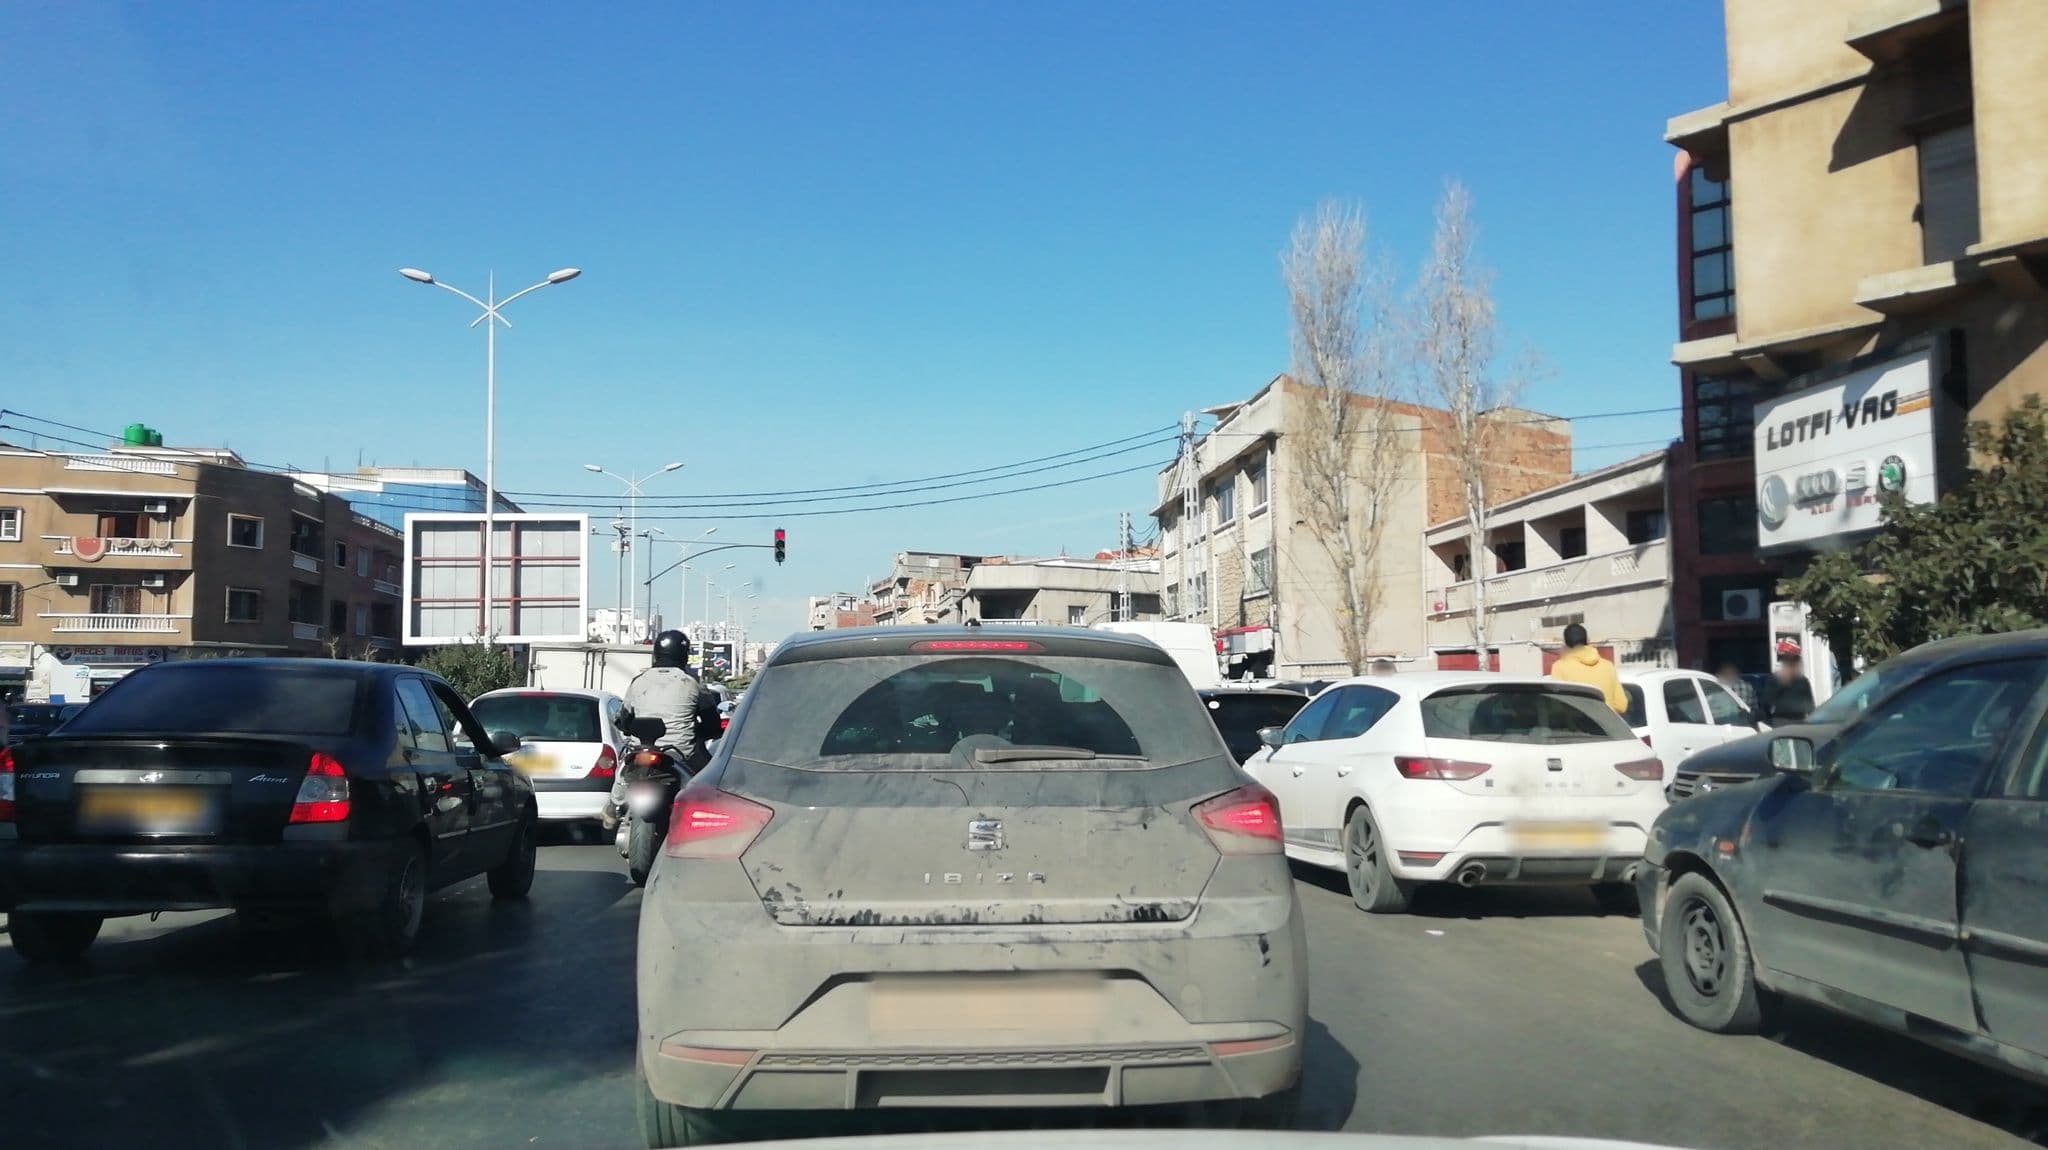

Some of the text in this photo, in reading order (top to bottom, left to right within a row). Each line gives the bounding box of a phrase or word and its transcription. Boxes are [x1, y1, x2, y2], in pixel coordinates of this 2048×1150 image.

[1767, 390, 1898, 451] LOTFI VAG
[924, 872, 1046, 884] IBIZA
